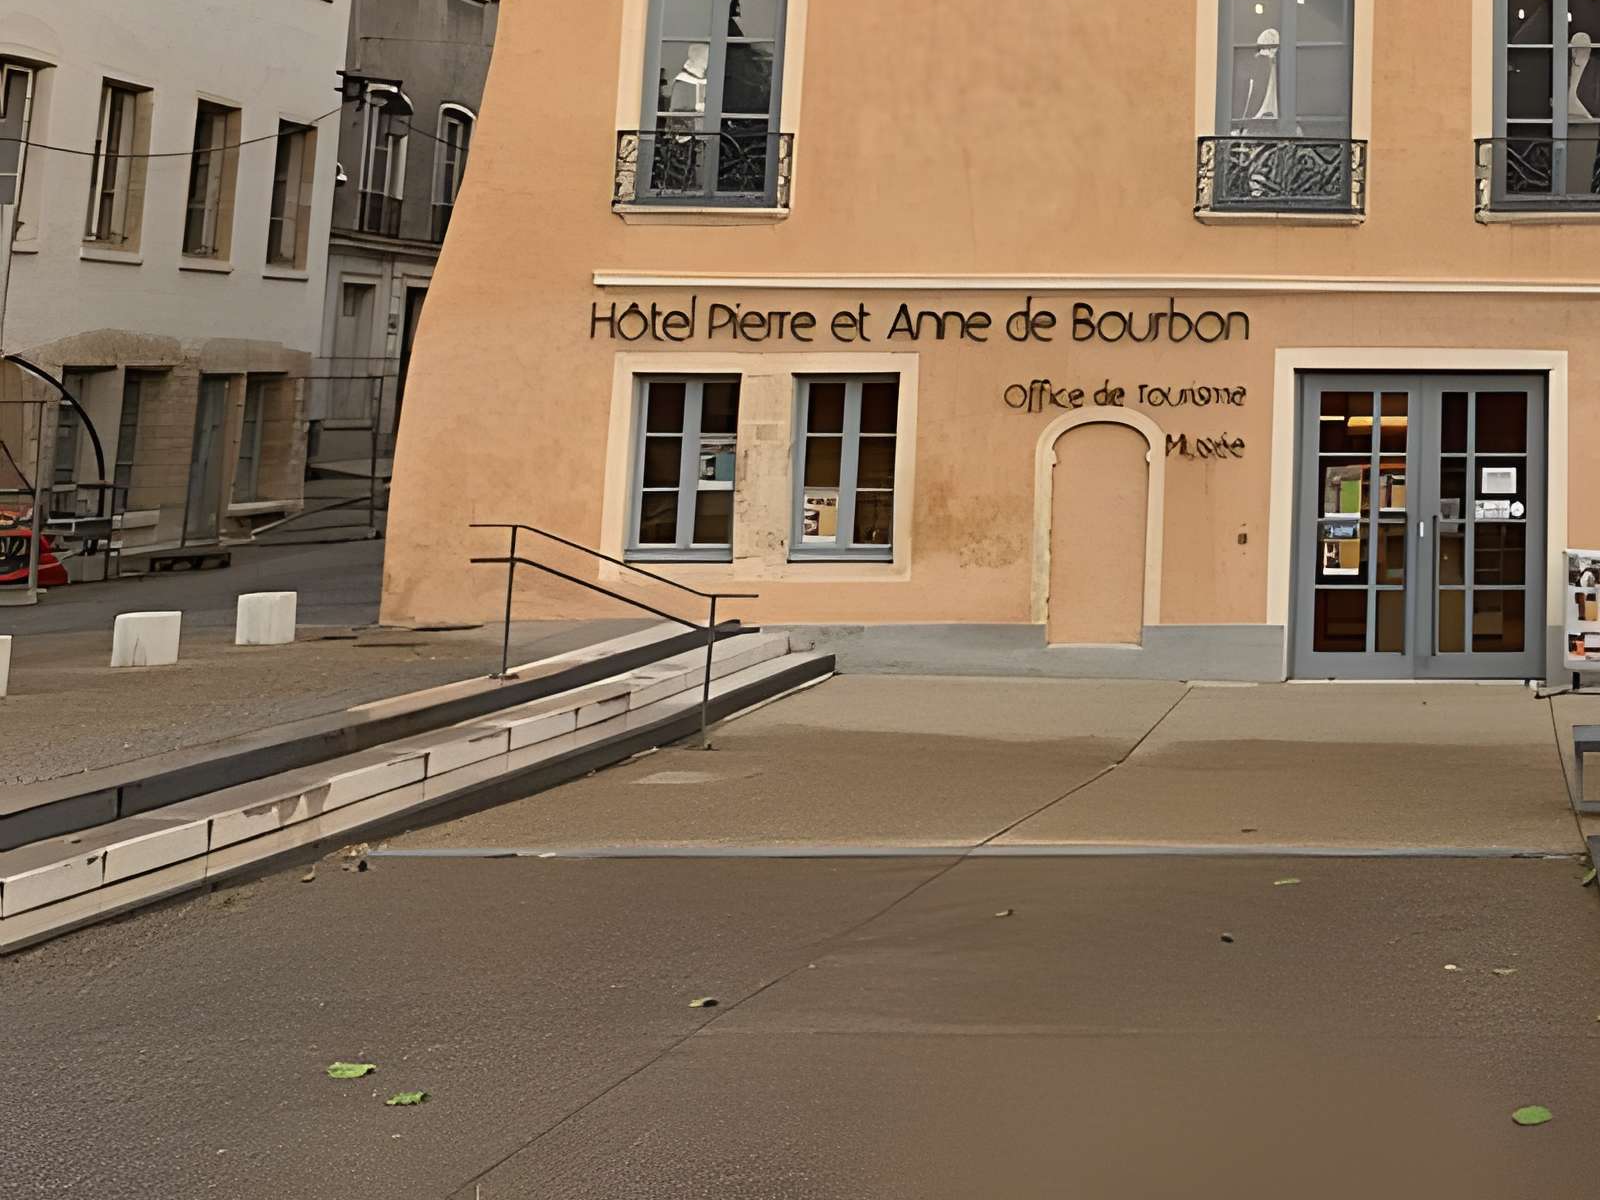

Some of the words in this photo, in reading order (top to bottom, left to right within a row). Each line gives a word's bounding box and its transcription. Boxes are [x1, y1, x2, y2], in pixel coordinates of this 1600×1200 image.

[590, 295, 697, 342] Hôtel
[708, 303, 817, 342] Pierre
[831, 303, 871, 342] et
[887, 302, 992, 342] Anne
[1006, 295, 1057, 342] de
[1072, 296, 1250, 343] Bourbon
[1093, 378, 1126, 408] de
